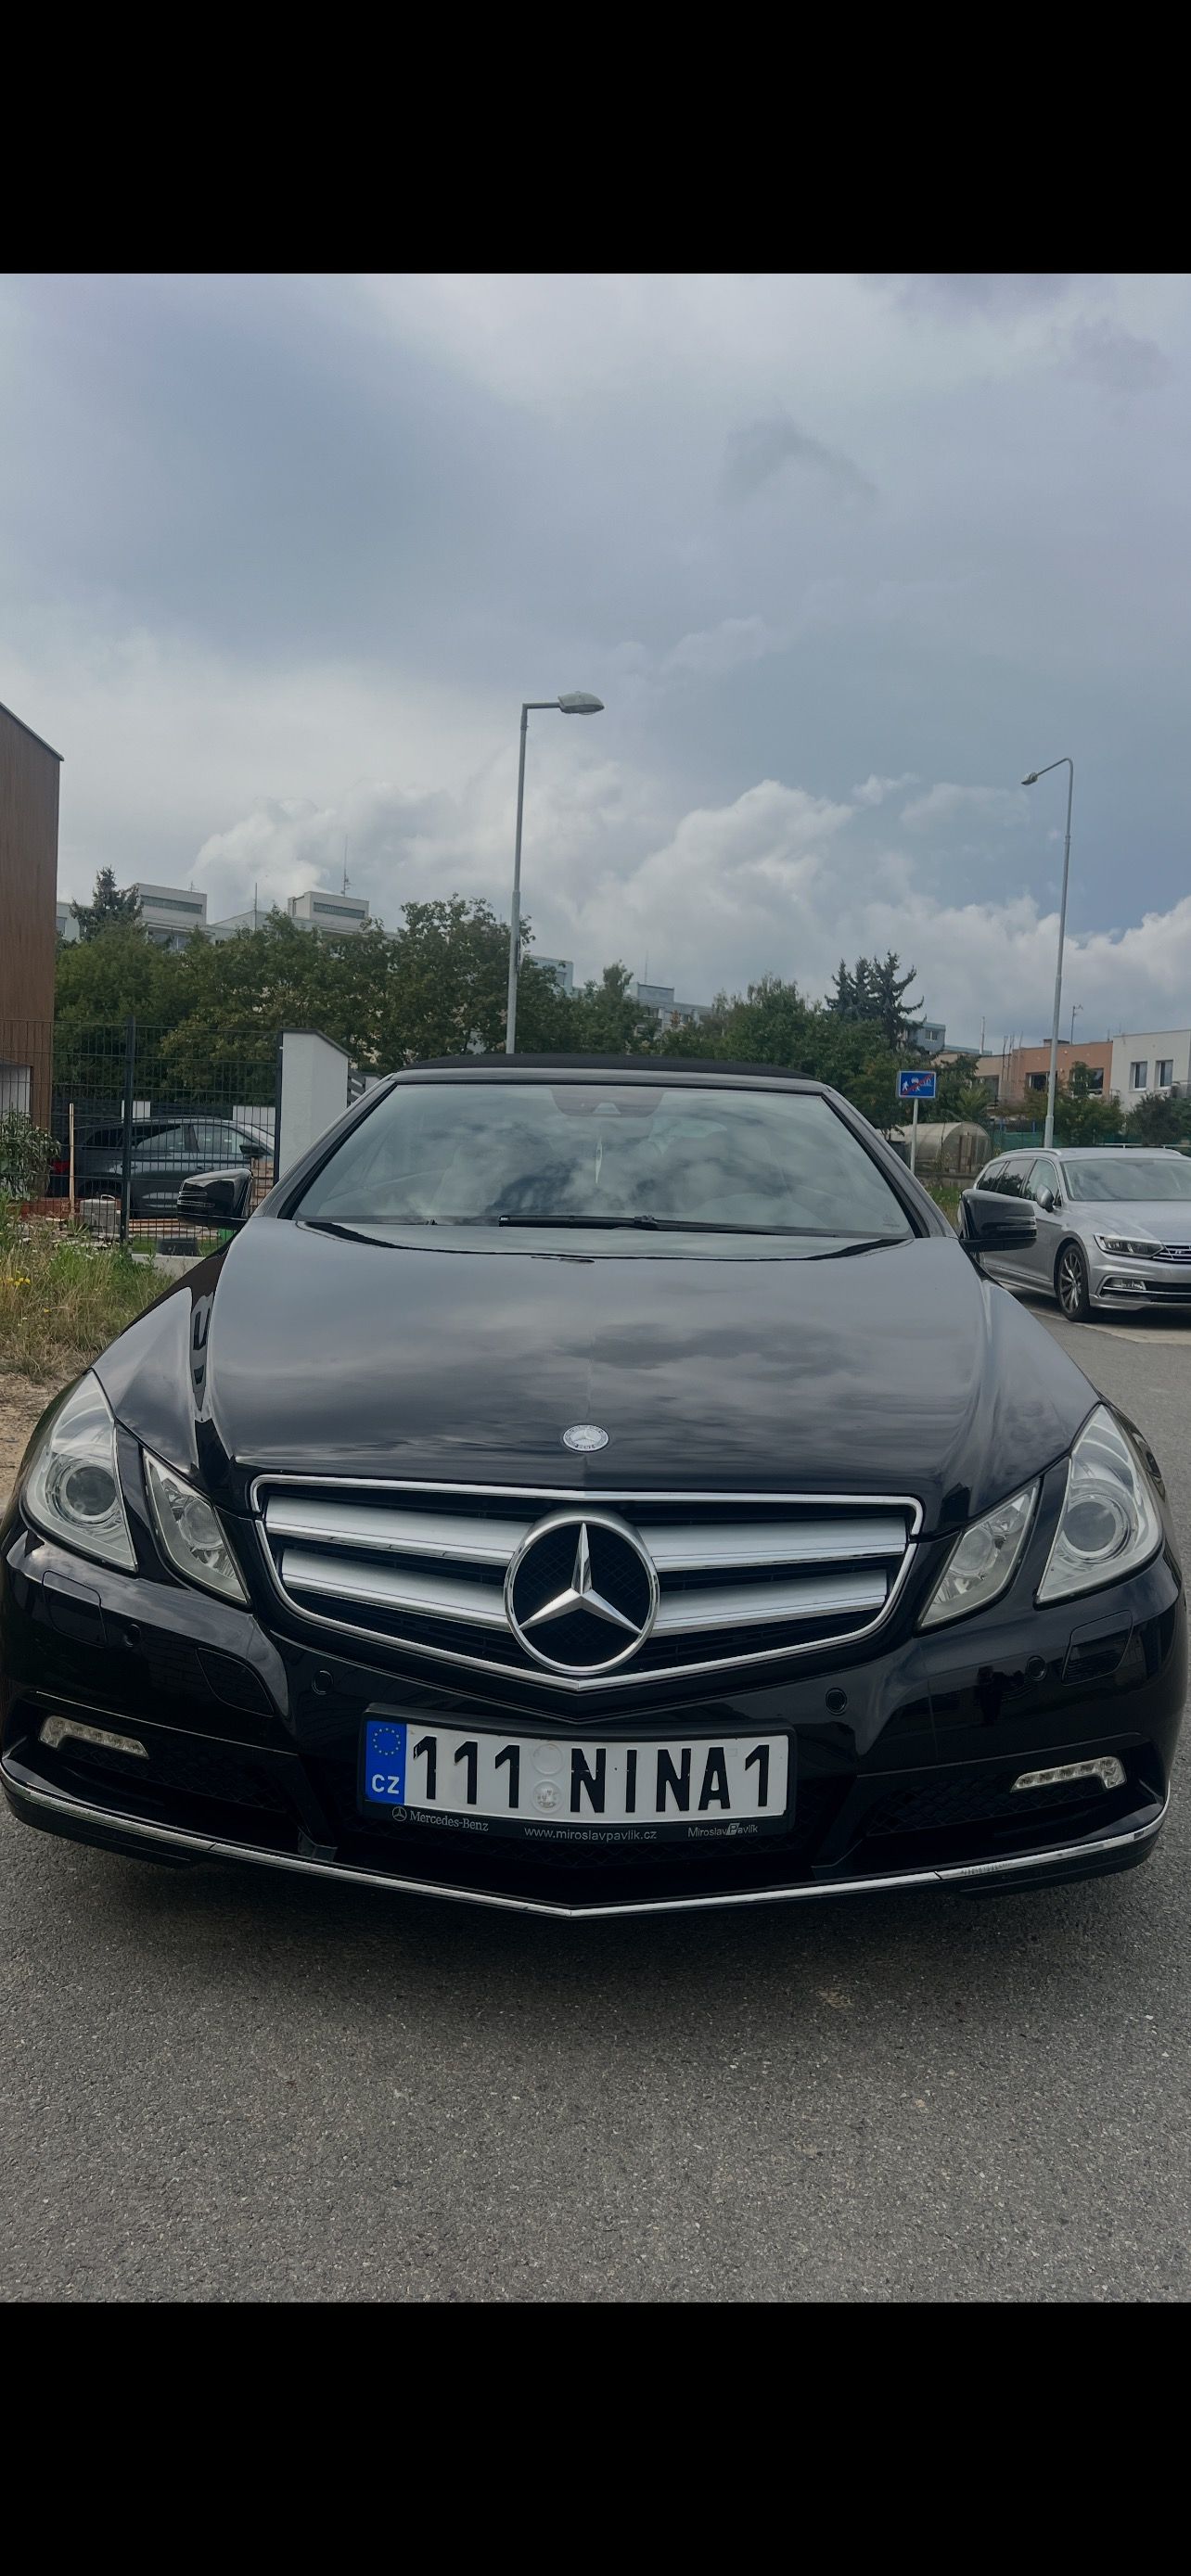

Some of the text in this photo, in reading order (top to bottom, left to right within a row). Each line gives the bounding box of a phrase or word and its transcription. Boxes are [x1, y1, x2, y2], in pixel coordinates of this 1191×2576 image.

[371, 1774, 400, 1793] CZ
[413, 1736, 770, 1813] 111 NINA1
[409, 1810, 489, 1831] Mercedes-Benz
[524, 1828, 657, 1842] www.miroslavpavlik.cz
